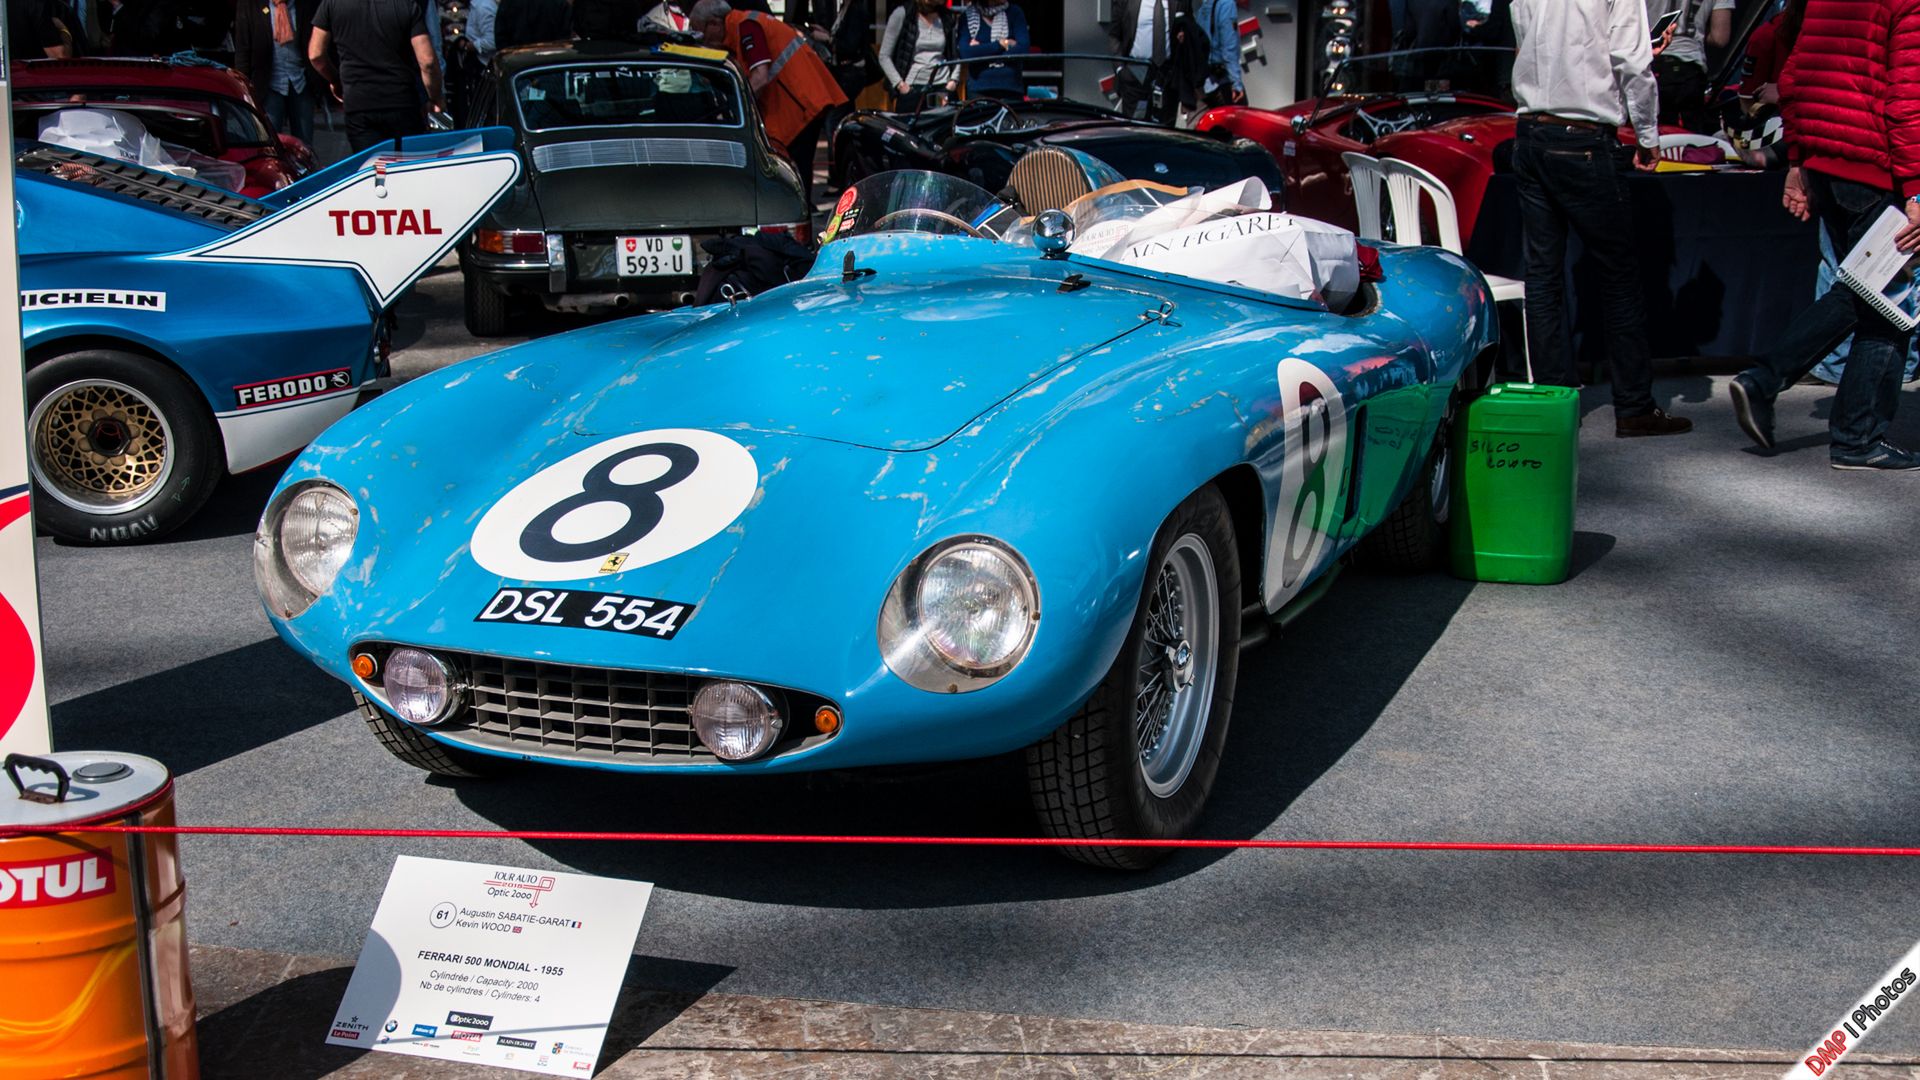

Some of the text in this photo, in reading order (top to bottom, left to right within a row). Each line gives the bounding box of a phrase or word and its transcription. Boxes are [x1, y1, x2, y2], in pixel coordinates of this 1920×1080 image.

[329, 209, 442, 236] TOTAL
[646, 238, 663, 252] VD
[239, 376, 327, 405] FERODO
[1282, 381, 1331, 588] 8
[519, 442, 700, 563] 8
[479, 589, 685, 636] DSL 554
[494, 871, 538, 884] TOUR AUTO
[487, 887, 532, 900] Optic 2000
[436, 910, 449, 920] 61
[459, 907, 572, 927] Augustin SABATIE-GARAT
[455, 919, 511, 933] Kevin WOOD
[417, 950, 463, 963] FERRARI
[464, 956, 482, 966] 500
[483, 958, 531, 972] MONDIAL
[540, 965, 564, 976] 1955
[429, 969, 469, 982] Cylindrée
[476, 975, 515, 990] Capacity:
[516, 981, 539, 991] 2000
[419, 980, 432, 990] Nb
[433, 982, 445, 991] de
[446, 984, 483, 997] cylindres
[490, 989, 532, 1003] Cylinders:
[534, 995, 541, 1003] 4
[335, 1021, 369, 1031] ZENITH
[341, 1031, 357, 1039] Point
[453, 1031, 480, 1041] MOTUL
